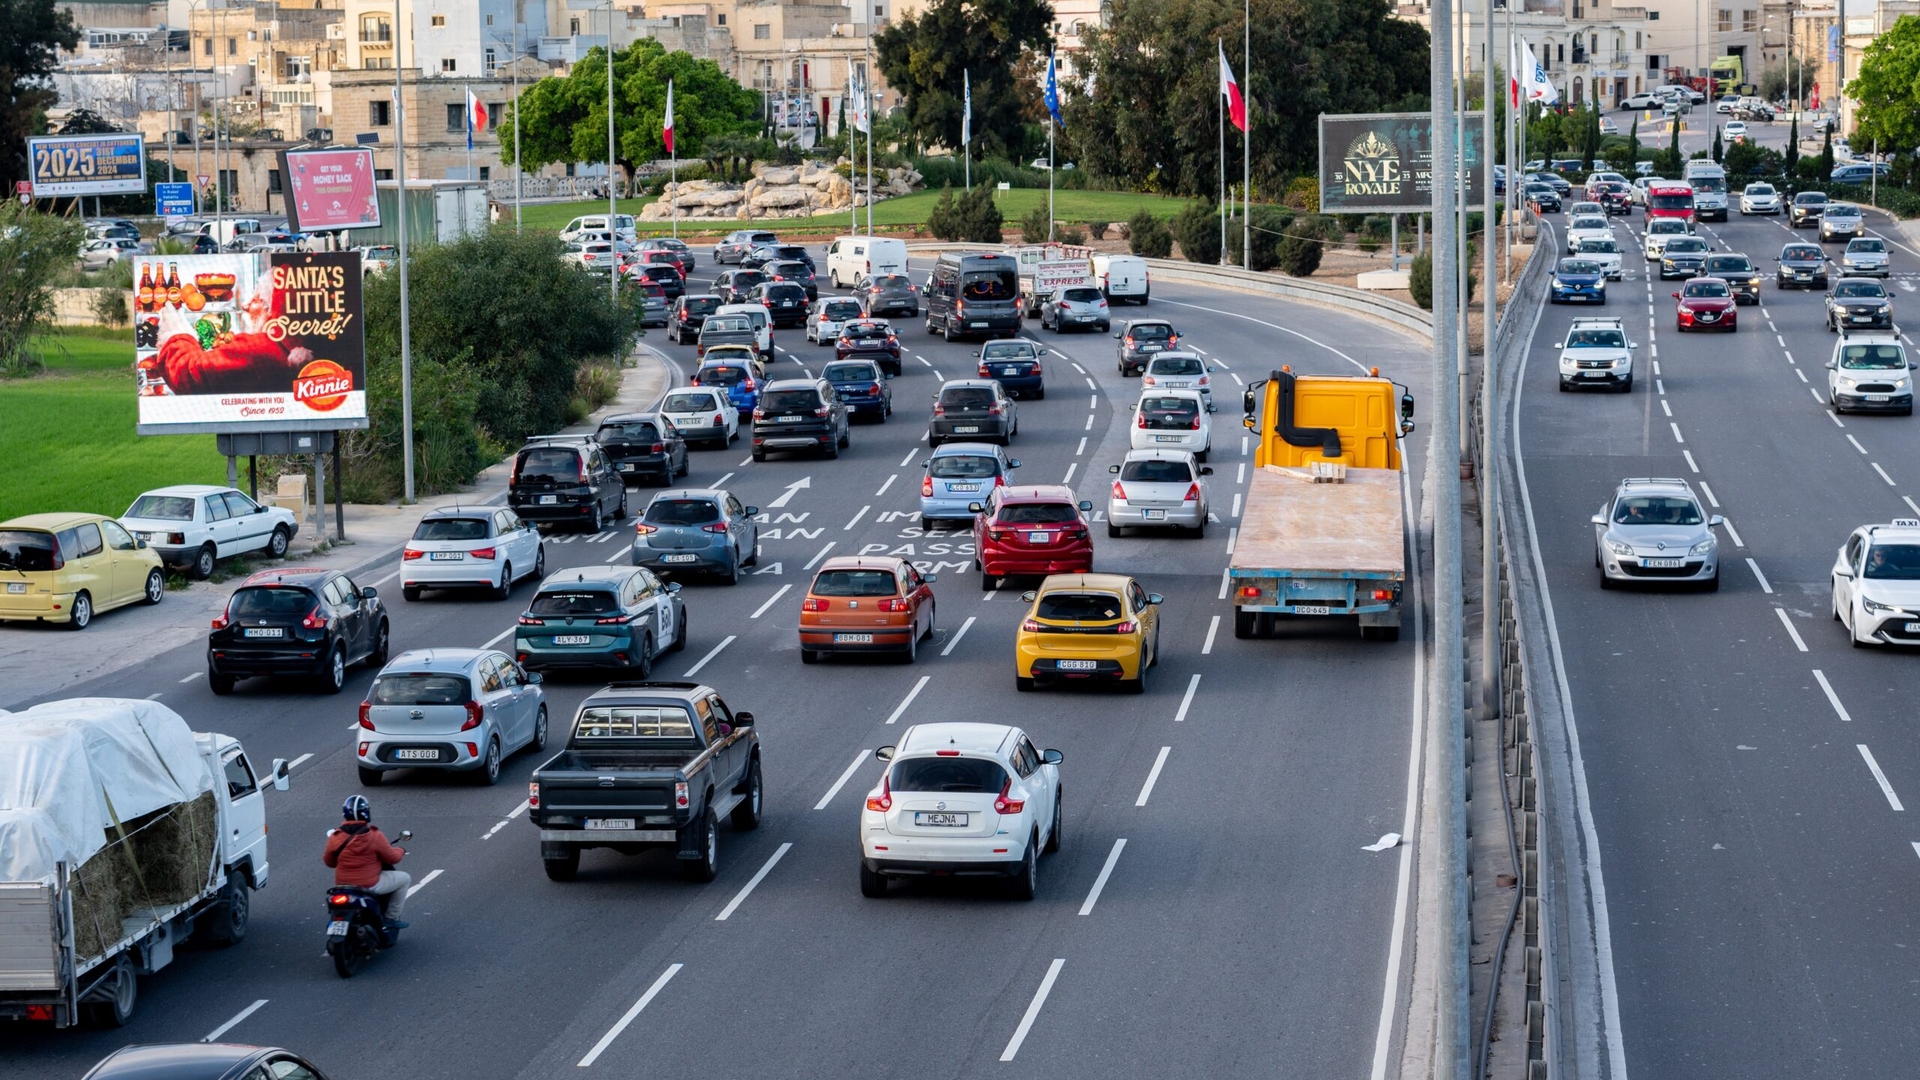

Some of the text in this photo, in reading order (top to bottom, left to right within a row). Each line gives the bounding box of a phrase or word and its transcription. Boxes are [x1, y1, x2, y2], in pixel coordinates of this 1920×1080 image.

[97, 148, 114, 156] 31ST
[37, 148, 95, 177] 2025
[97, 155, 137, 165] DECEMBER
[98, 166, 117, 174] 2024
[1344, 160, 1400, 182] NYE
[313, 174, 352, 184] MONEY BACK
[1345, 182, 1400, 195] ROYALE
[273, 266, 344, 289] SANTA'S
[285, 291, 345, 314] LITTLE
[262, 314, 353, 342] Secret!
[297, 378, 350, 399] Kinnie
[240, 407, 265, 417] Since
[928, 815, 956, 824] MEJNA
